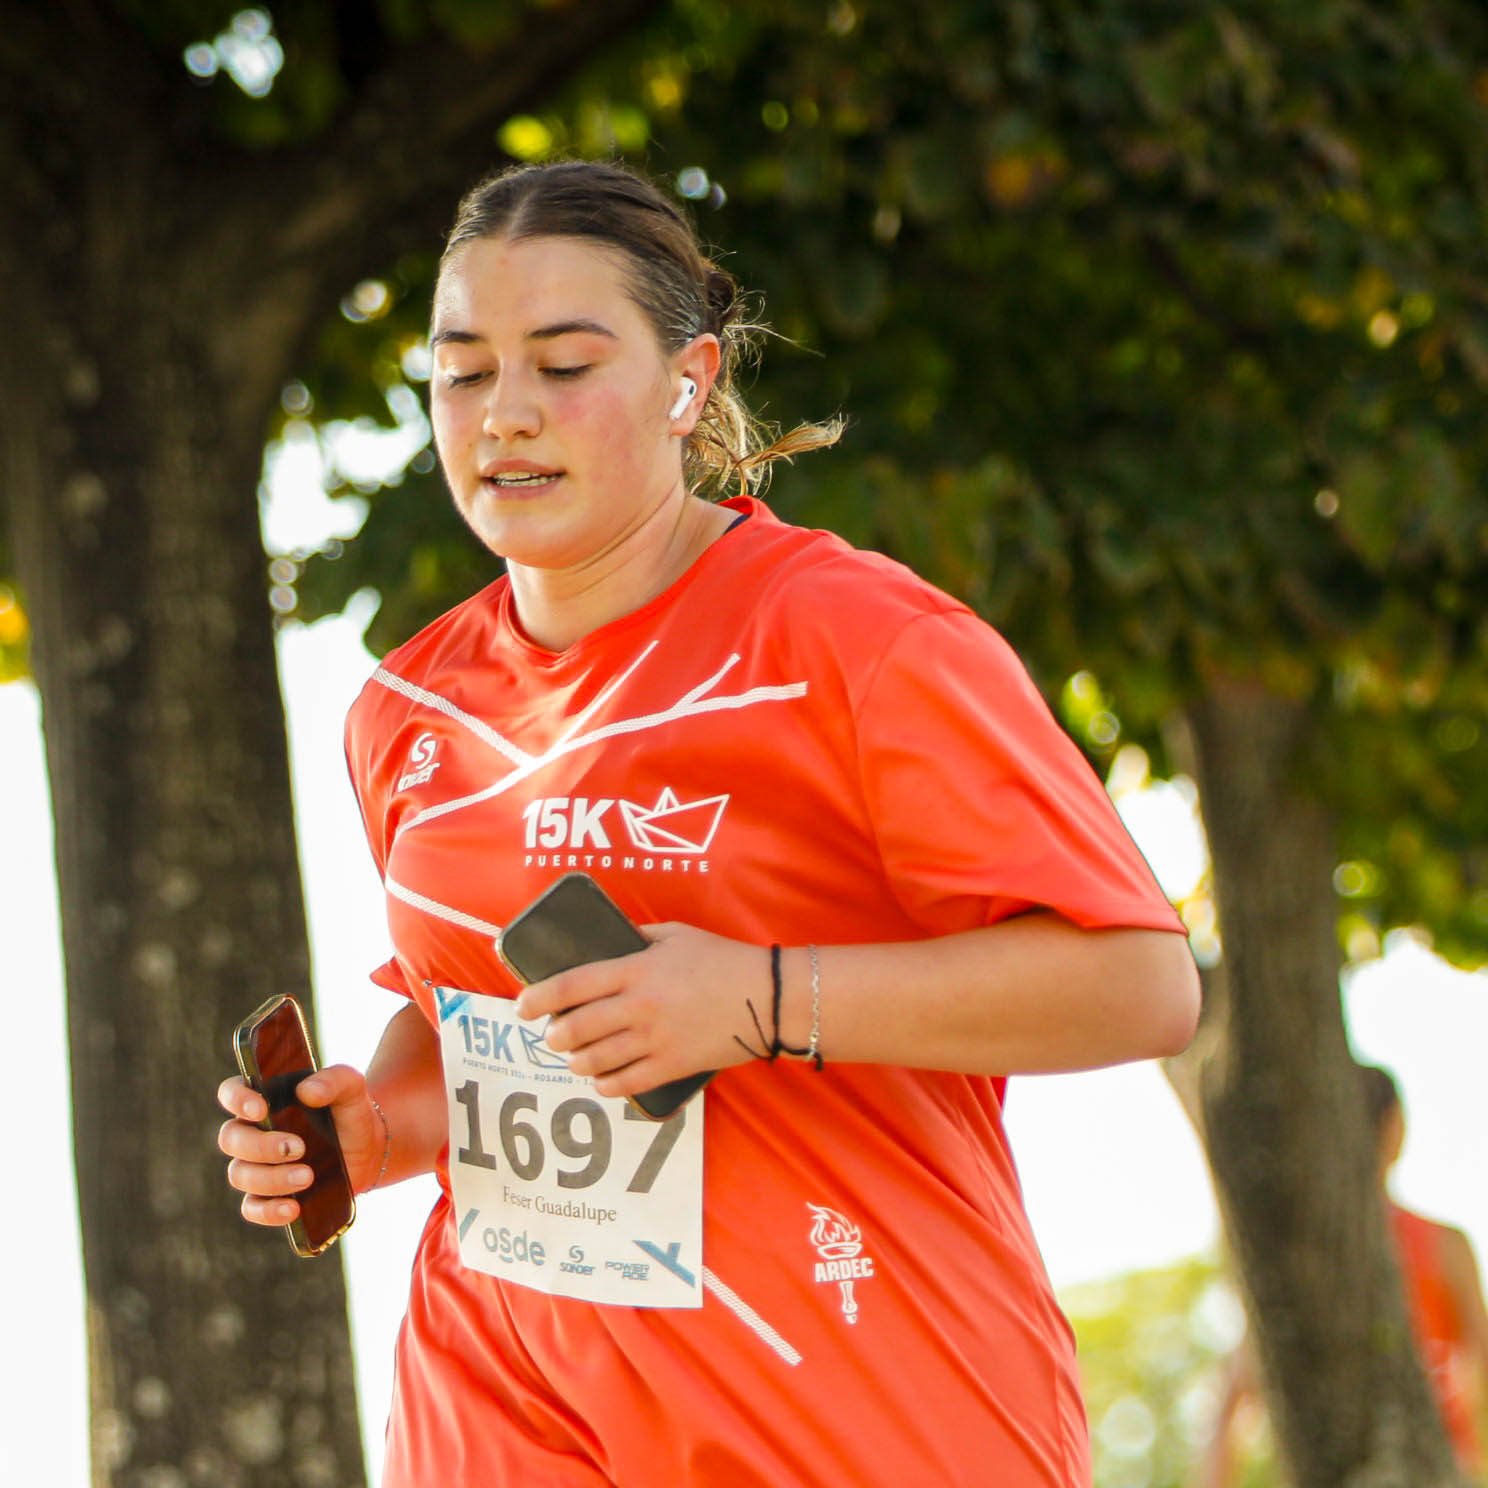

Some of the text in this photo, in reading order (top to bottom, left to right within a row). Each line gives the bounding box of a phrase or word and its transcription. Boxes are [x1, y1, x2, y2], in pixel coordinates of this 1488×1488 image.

[522, 797, 616, 849] 15K
[525, 854, 710, 873] PUERTO NORTE
[458, 1014, 516, 1064] 15K
[453, 1078, 687, 1194] 1697
[502, 1185, 618, 1226] Feser Guadalupe
[482, 1226, 547, 1267] osde
[605, 1260, 650, 1273] POWER
[814, 1257, 876, 1283] ARDEC
